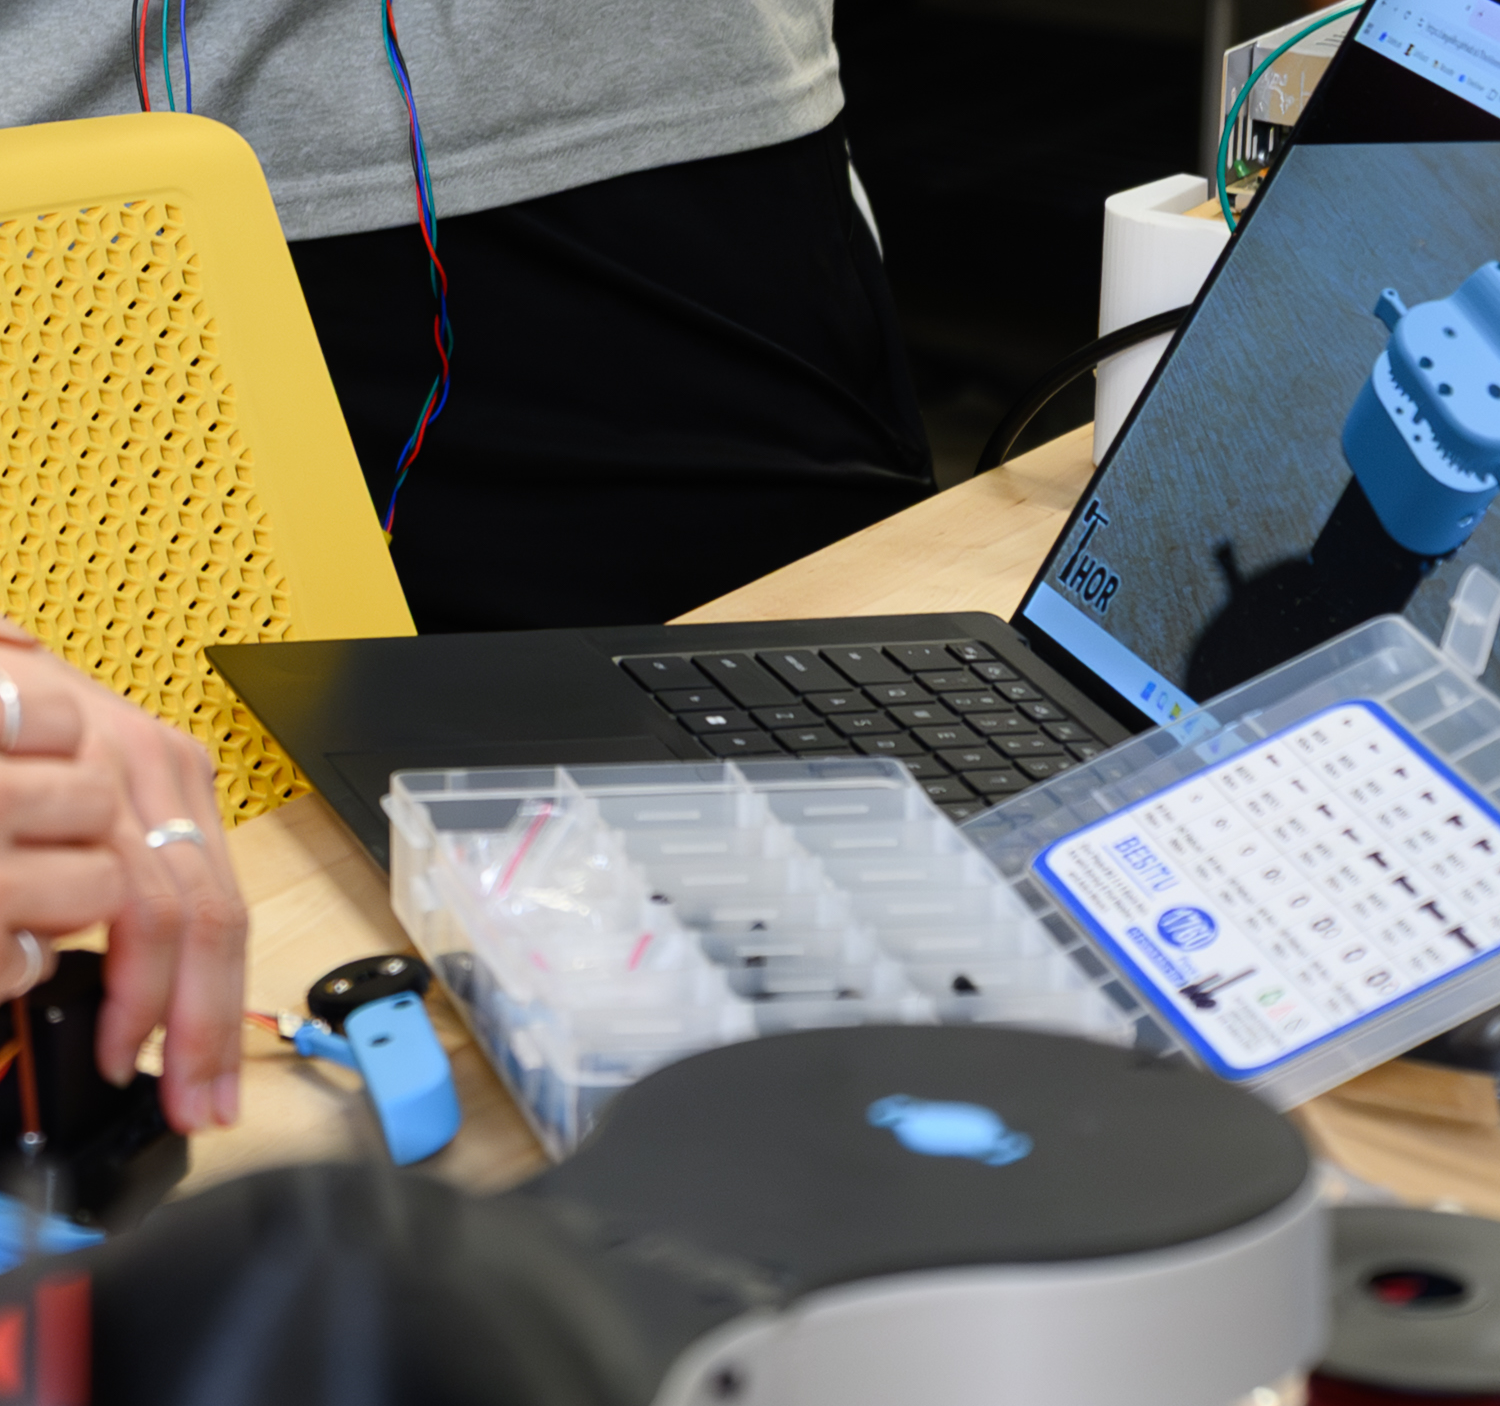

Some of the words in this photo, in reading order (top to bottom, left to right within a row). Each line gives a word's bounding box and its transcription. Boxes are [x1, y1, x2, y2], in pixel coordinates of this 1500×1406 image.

[1058, 499, 1119, 613] THOR
[1113, 834, 1180, 895] BESITU
[1160, 909, 1215, 950] 1760
